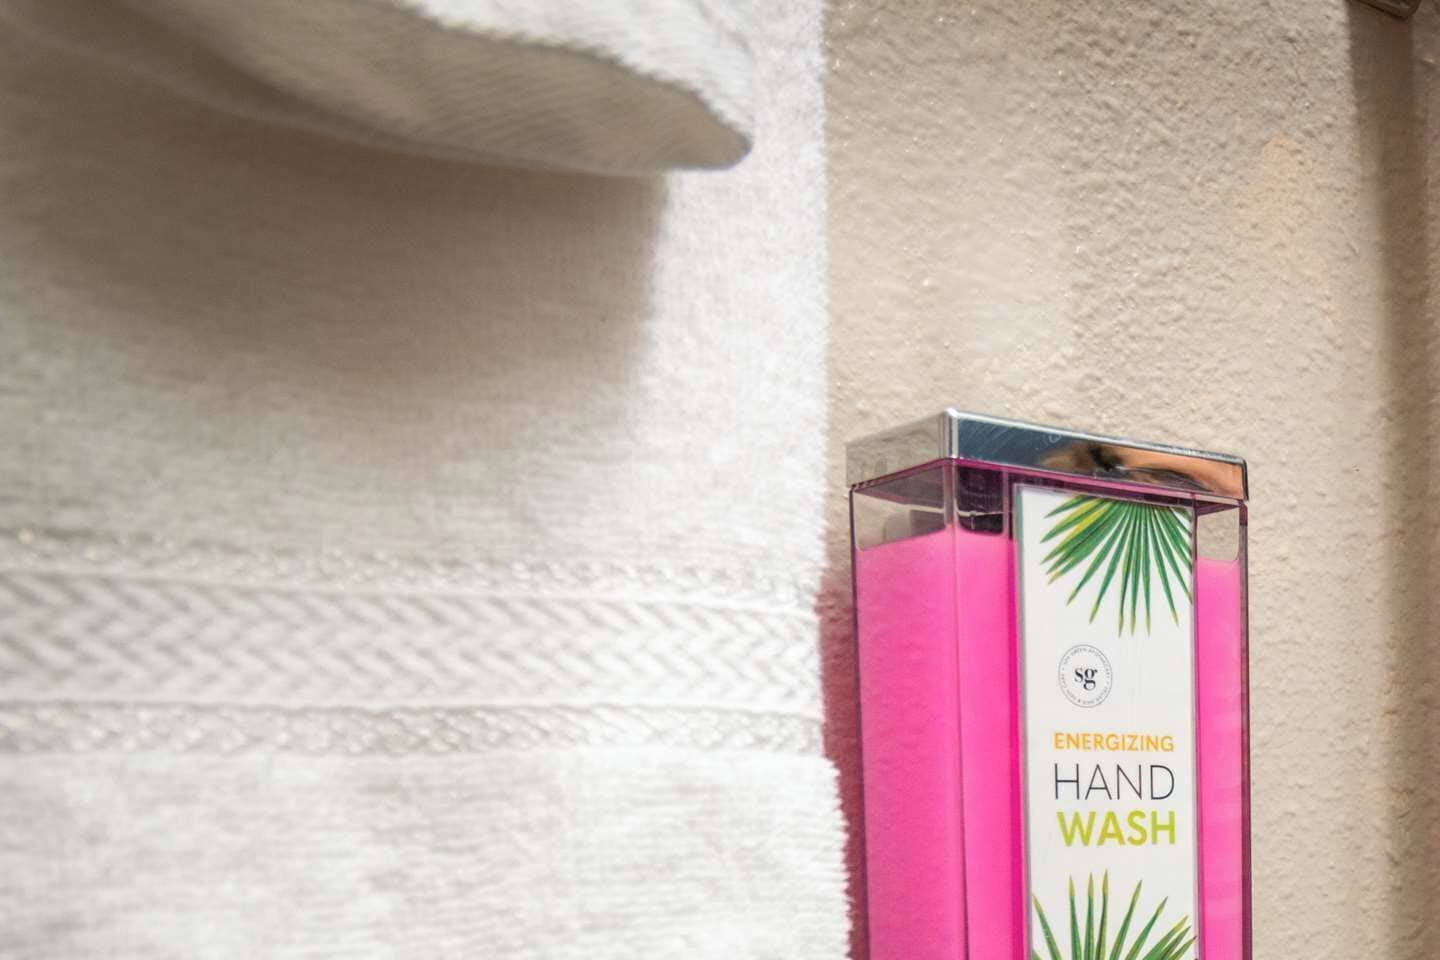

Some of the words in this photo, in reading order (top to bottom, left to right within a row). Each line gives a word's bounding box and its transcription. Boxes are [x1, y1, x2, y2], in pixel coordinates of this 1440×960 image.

[1074, 667, 1098, 691] sg
[1054, 732, 1174, 752] ENERGIZING
[1054, 763, 1175, 801] HAND
[1057, 810, 1176, 847] WASH
